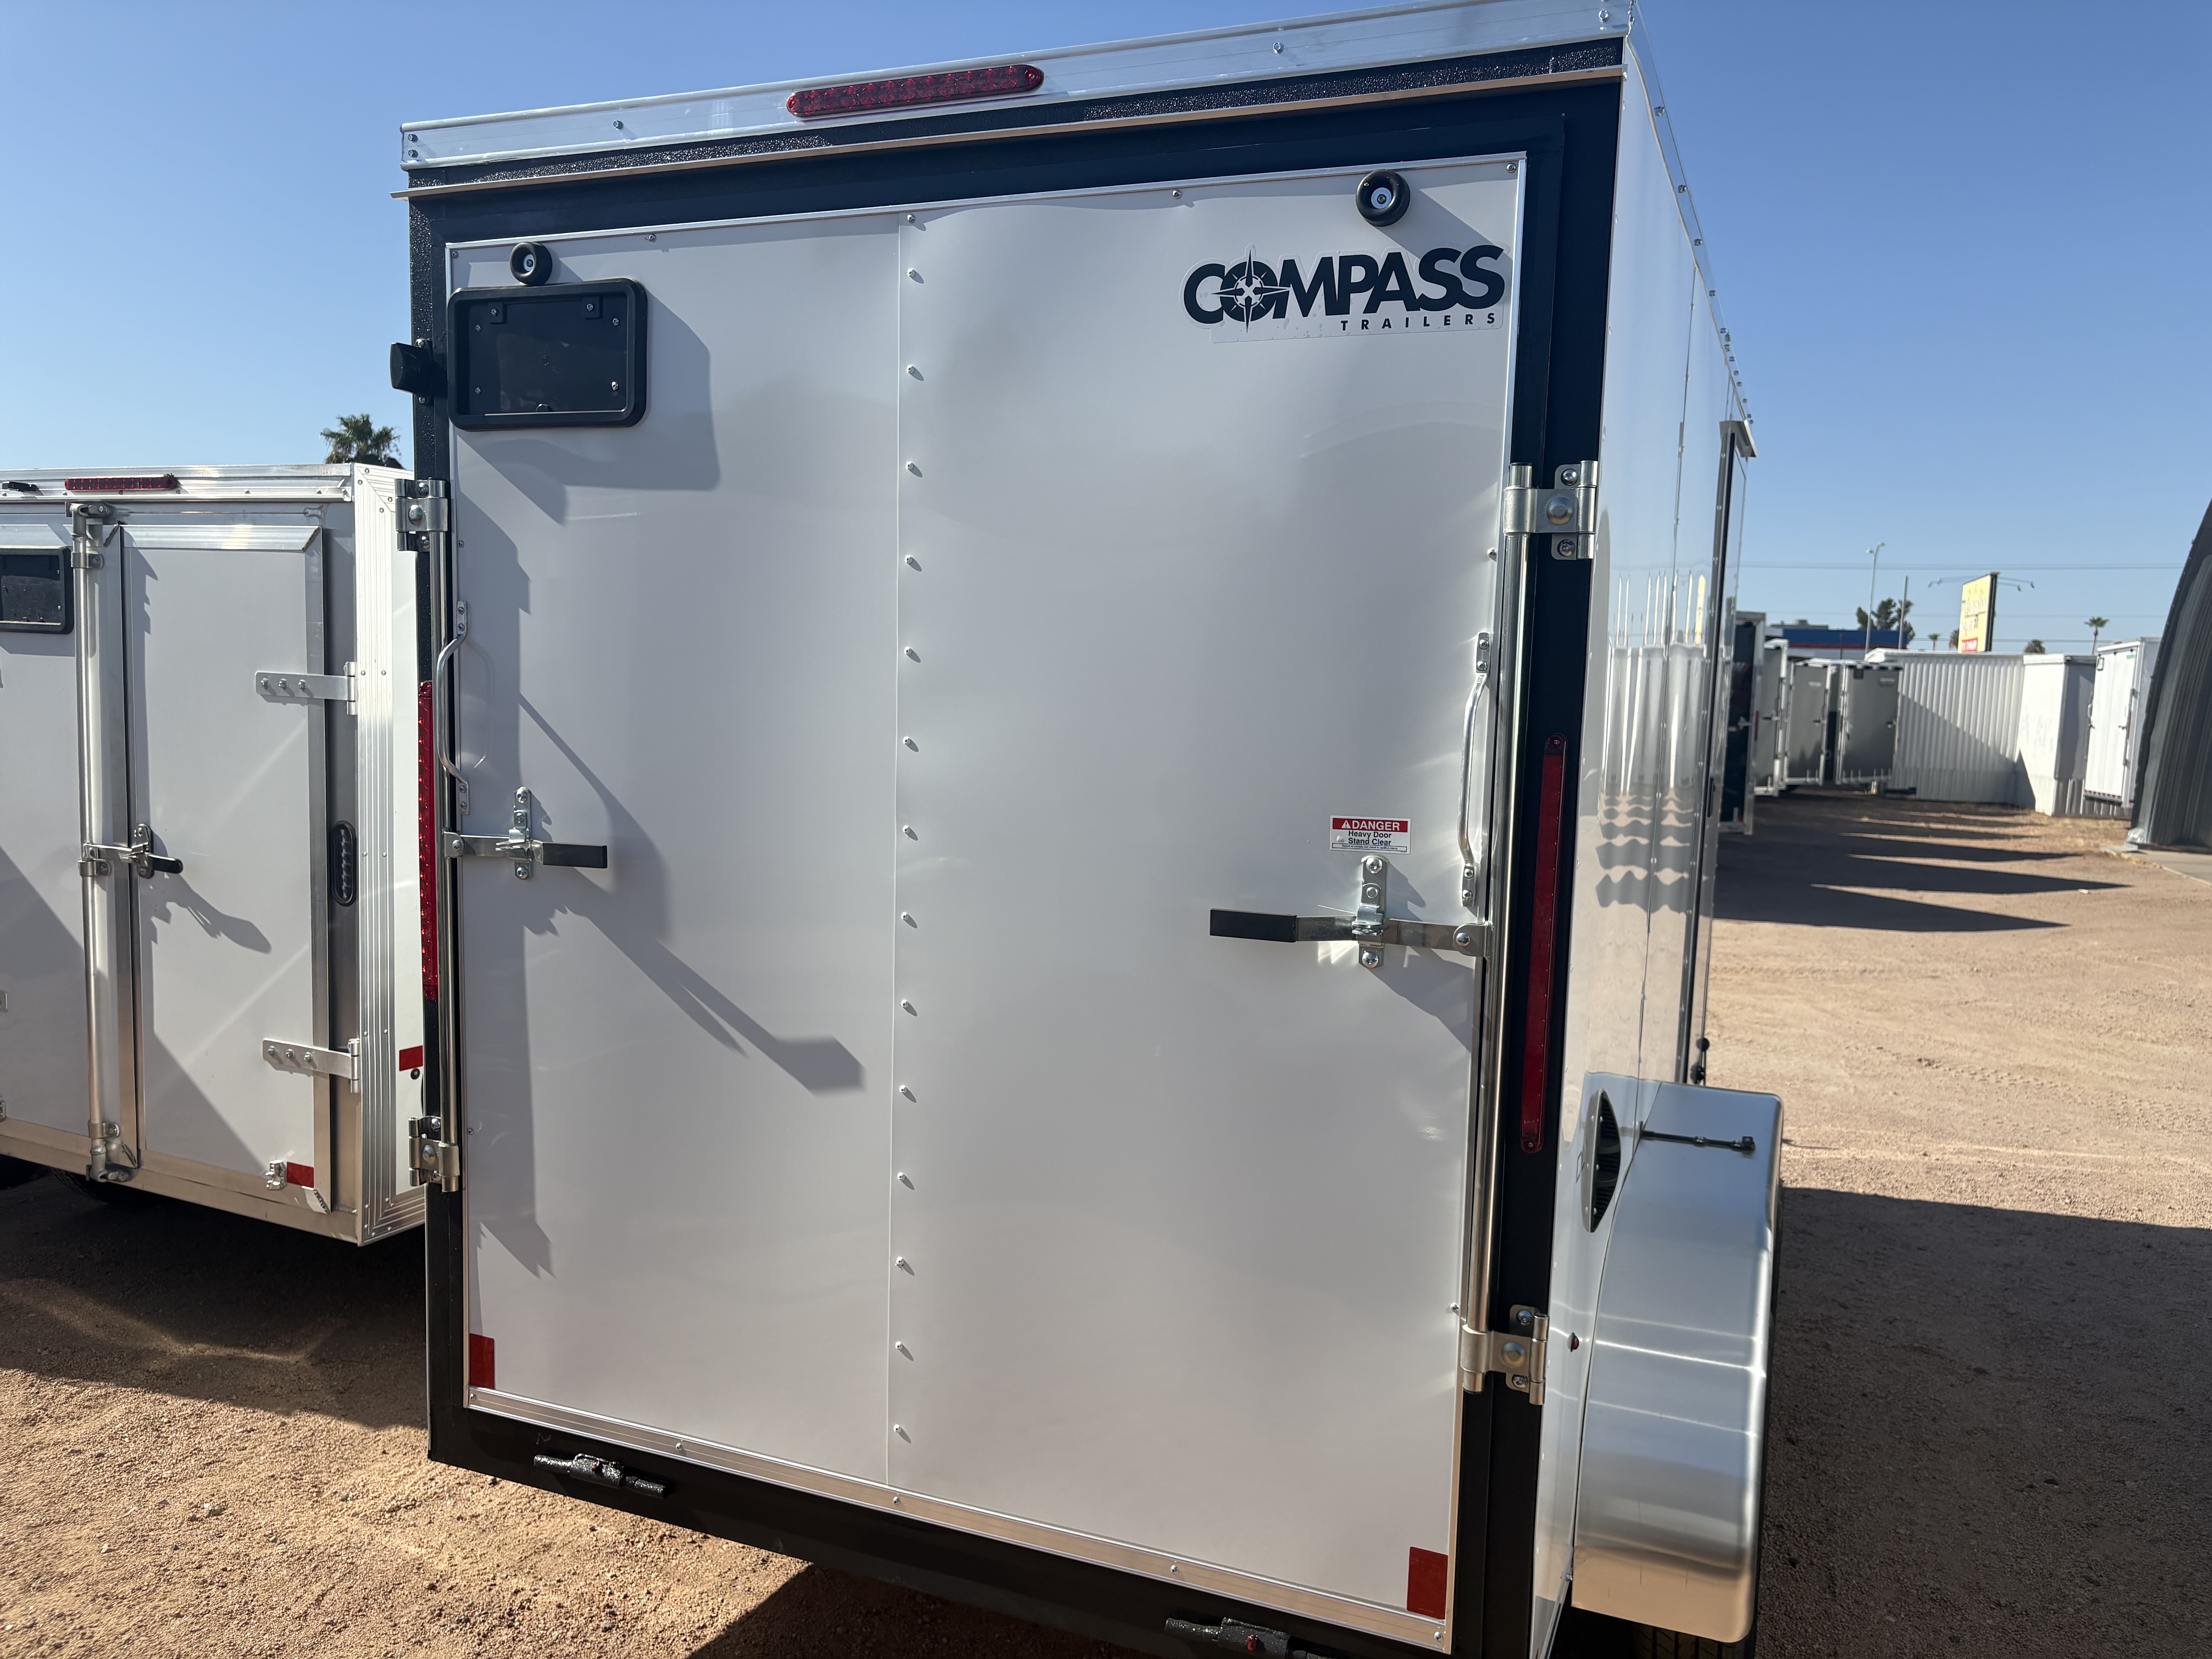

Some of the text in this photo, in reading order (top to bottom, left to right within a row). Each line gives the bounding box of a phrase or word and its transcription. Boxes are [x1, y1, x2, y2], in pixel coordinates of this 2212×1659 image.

[1183, 245, 1505, 325] COMPASS
[1341, 313, 1495, 331] TRAILERS
[1352, 820, 1400, 831] DANGER
[1348, 830, 1371, 838] Heavy
